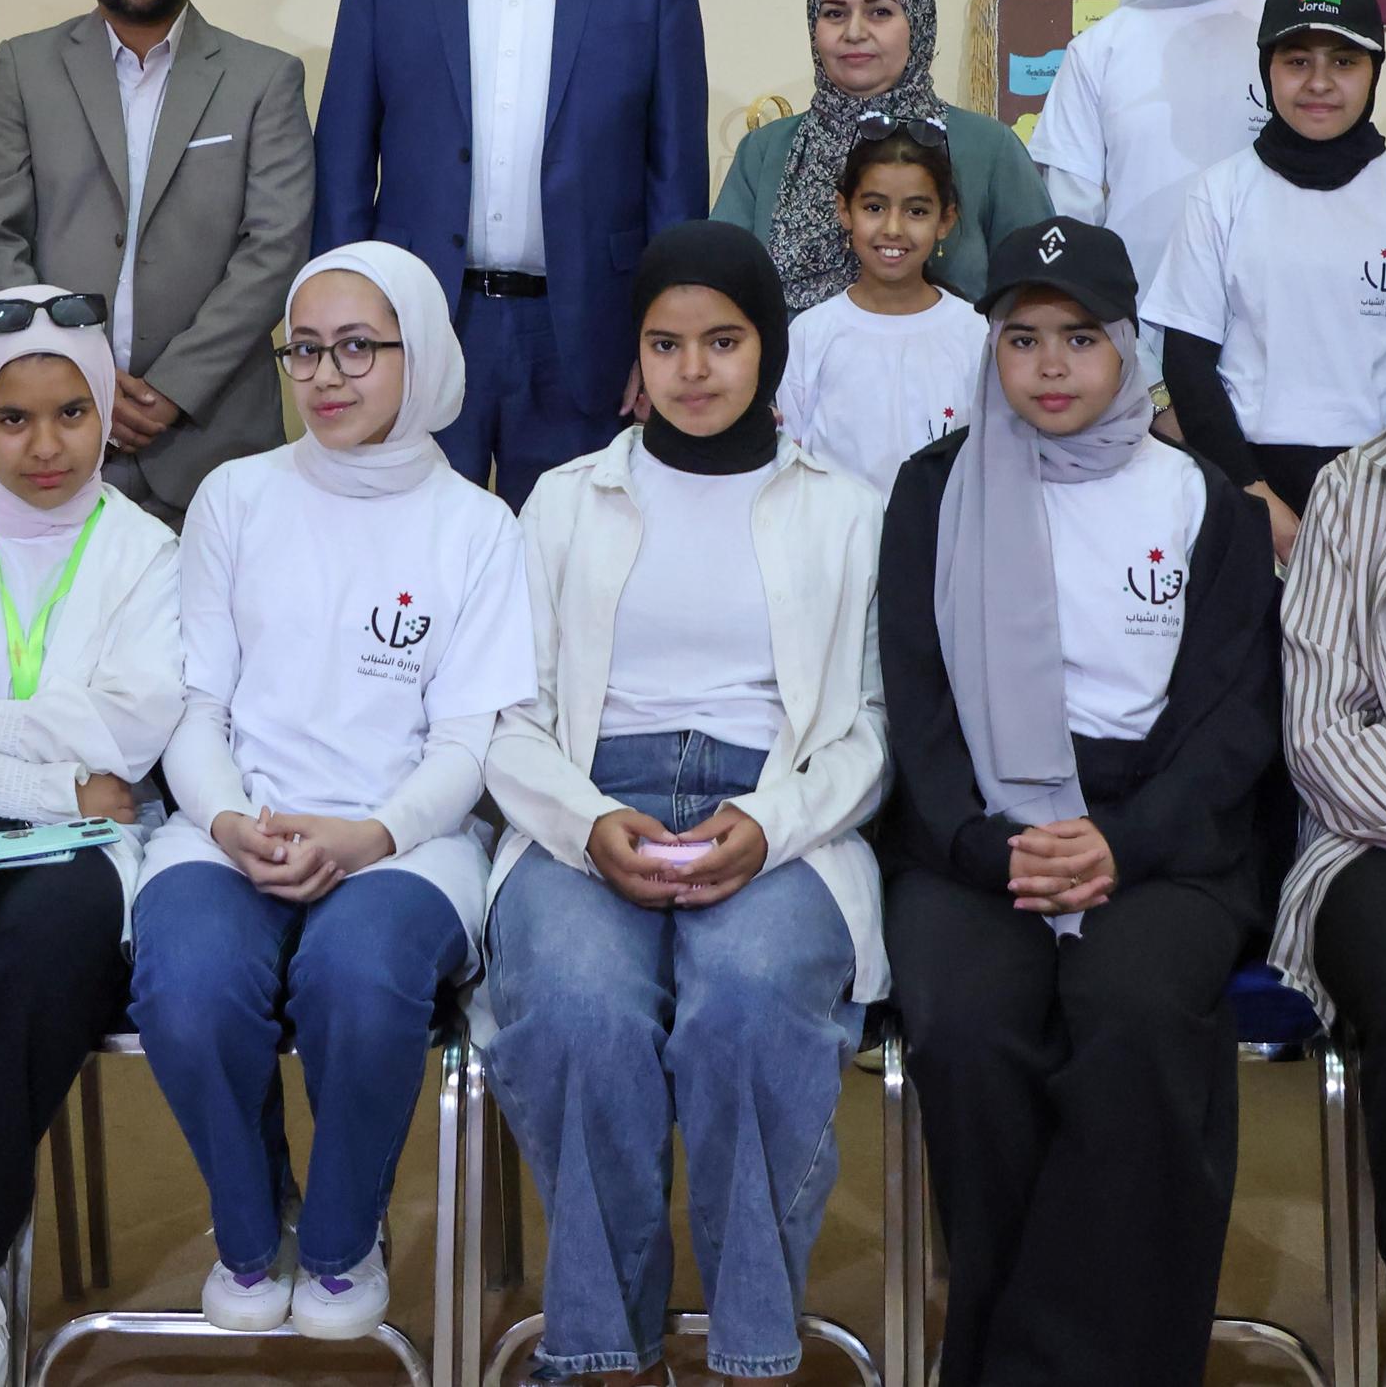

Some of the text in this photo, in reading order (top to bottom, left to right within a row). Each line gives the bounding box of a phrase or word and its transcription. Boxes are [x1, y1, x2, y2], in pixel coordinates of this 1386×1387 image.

[1299, 1, 1340, 15] Jordan
[1125, 611, 1180, 626] وزارة الشباب
[360, 653, 421, 673] وزارة الشباب
